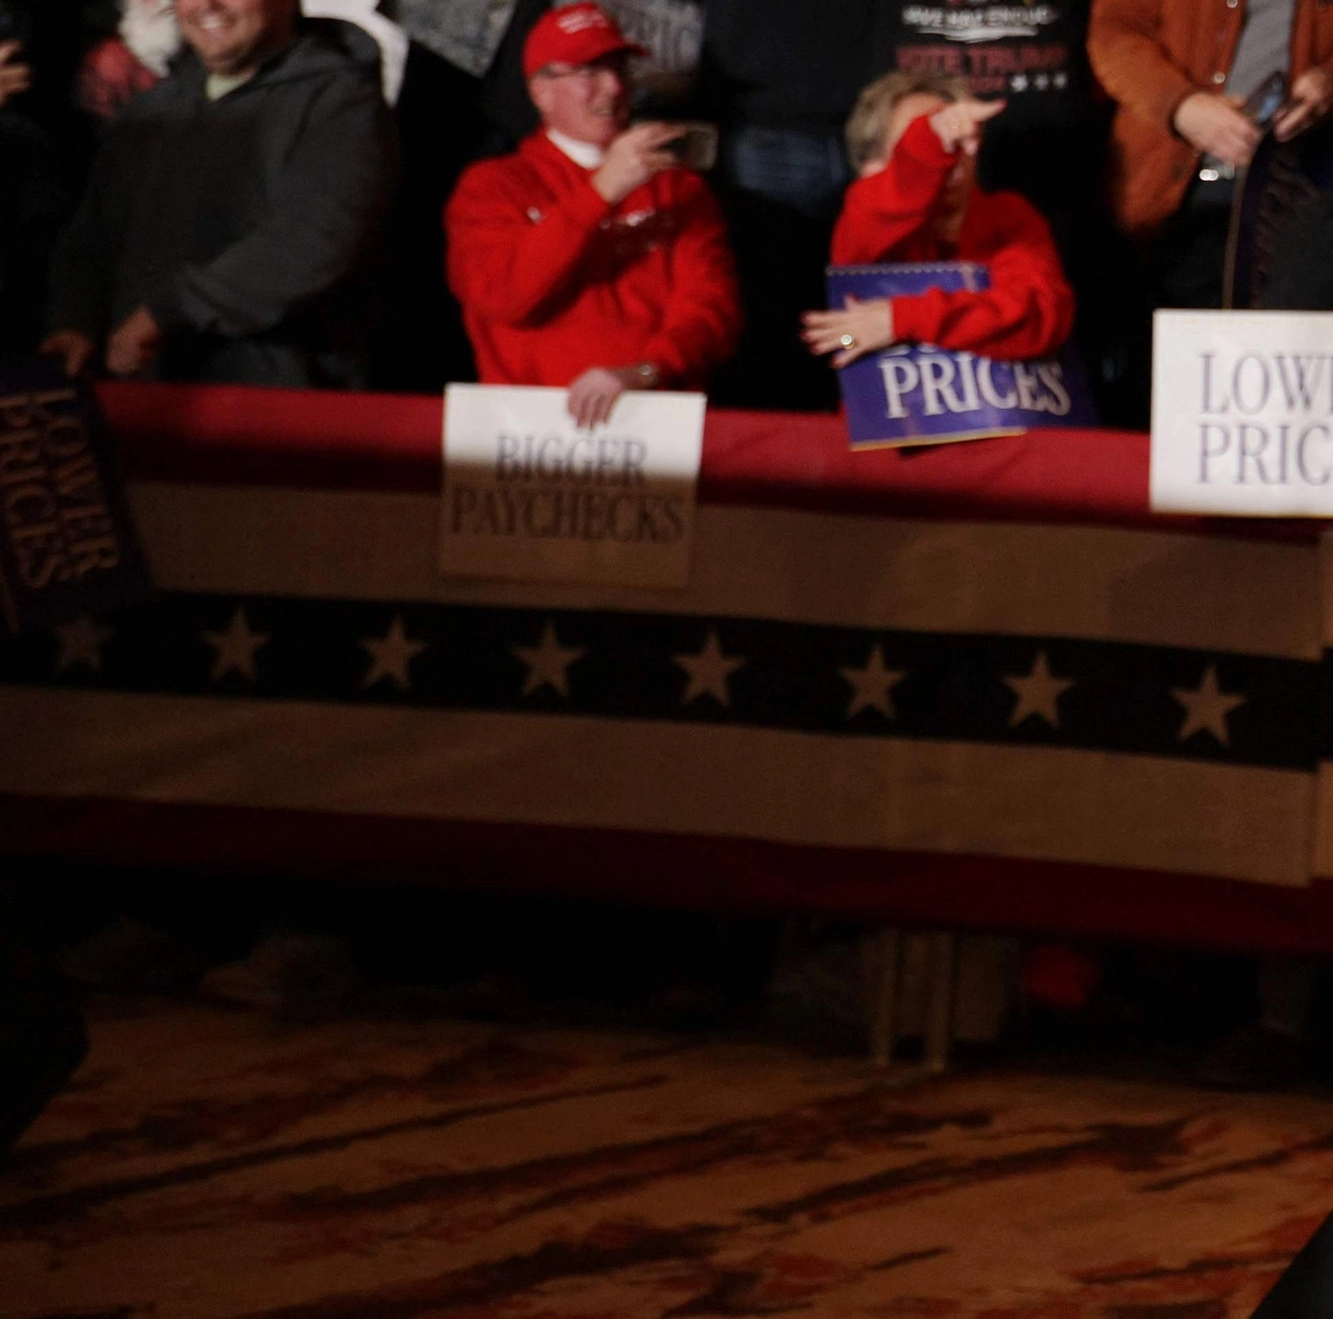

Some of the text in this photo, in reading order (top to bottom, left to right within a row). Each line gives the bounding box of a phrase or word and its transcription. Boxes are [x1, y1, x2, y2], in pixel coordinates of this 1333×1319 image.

[878, 351, 1072, 419] PRICES
[496, 436, 649, 487] BIGGER
[452, 487, 684, 543] PAYCHECKS
